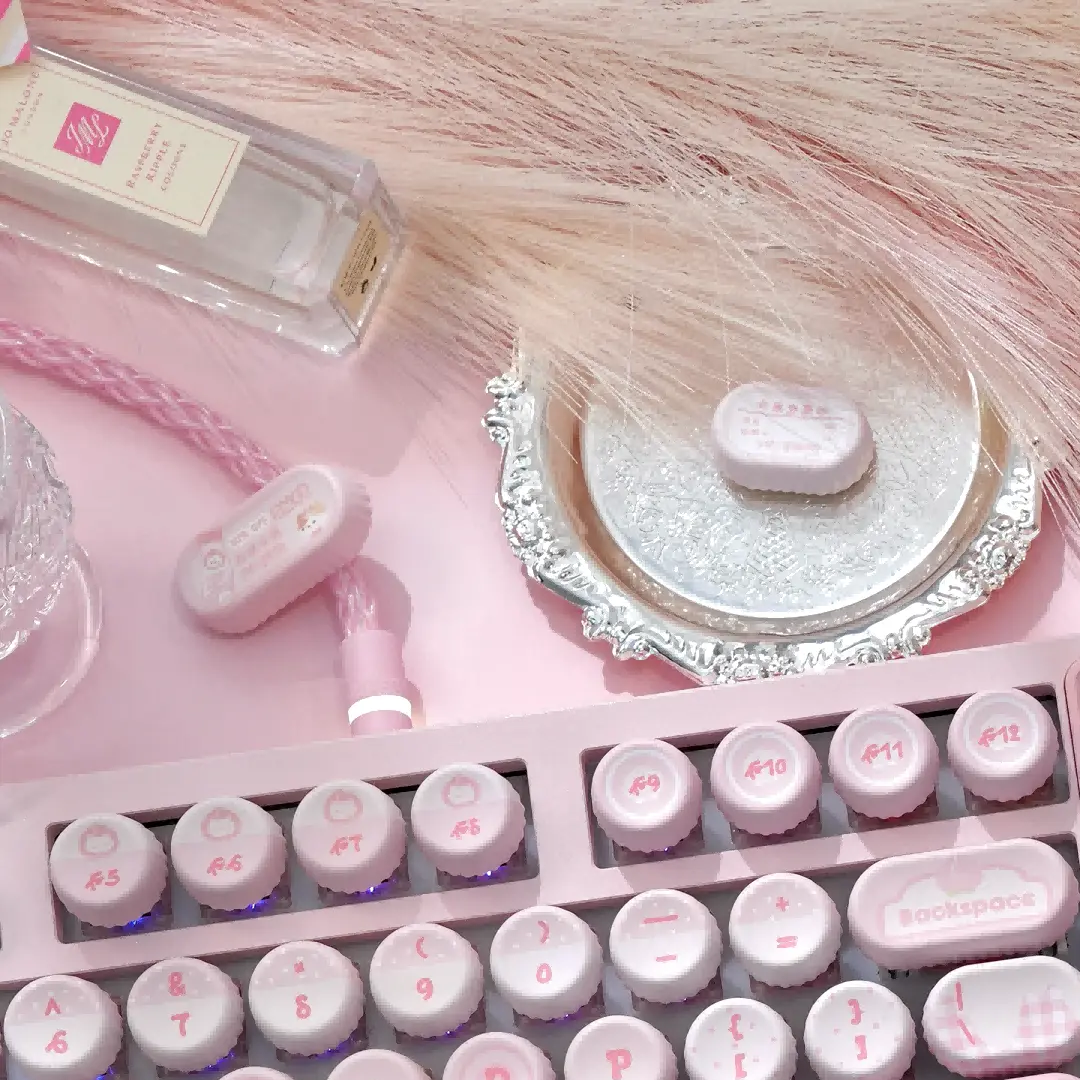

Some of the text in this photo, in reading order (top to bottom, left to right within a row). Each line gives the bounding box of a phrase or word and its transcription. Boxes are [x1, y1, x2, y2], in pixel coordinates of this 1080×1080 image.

[977, 723, 1021, 748] F12
[861, 742, 903, 765] F11
[744, 758, 787, 780] F10
[900, 892, 1036, 927] Backspace
[415, 977, 433, 1001] 9
[170, 1012, 191, 1037] 7
[46, 1031, 68, 1054] 6
[605, 1048, 631, 1080] P
